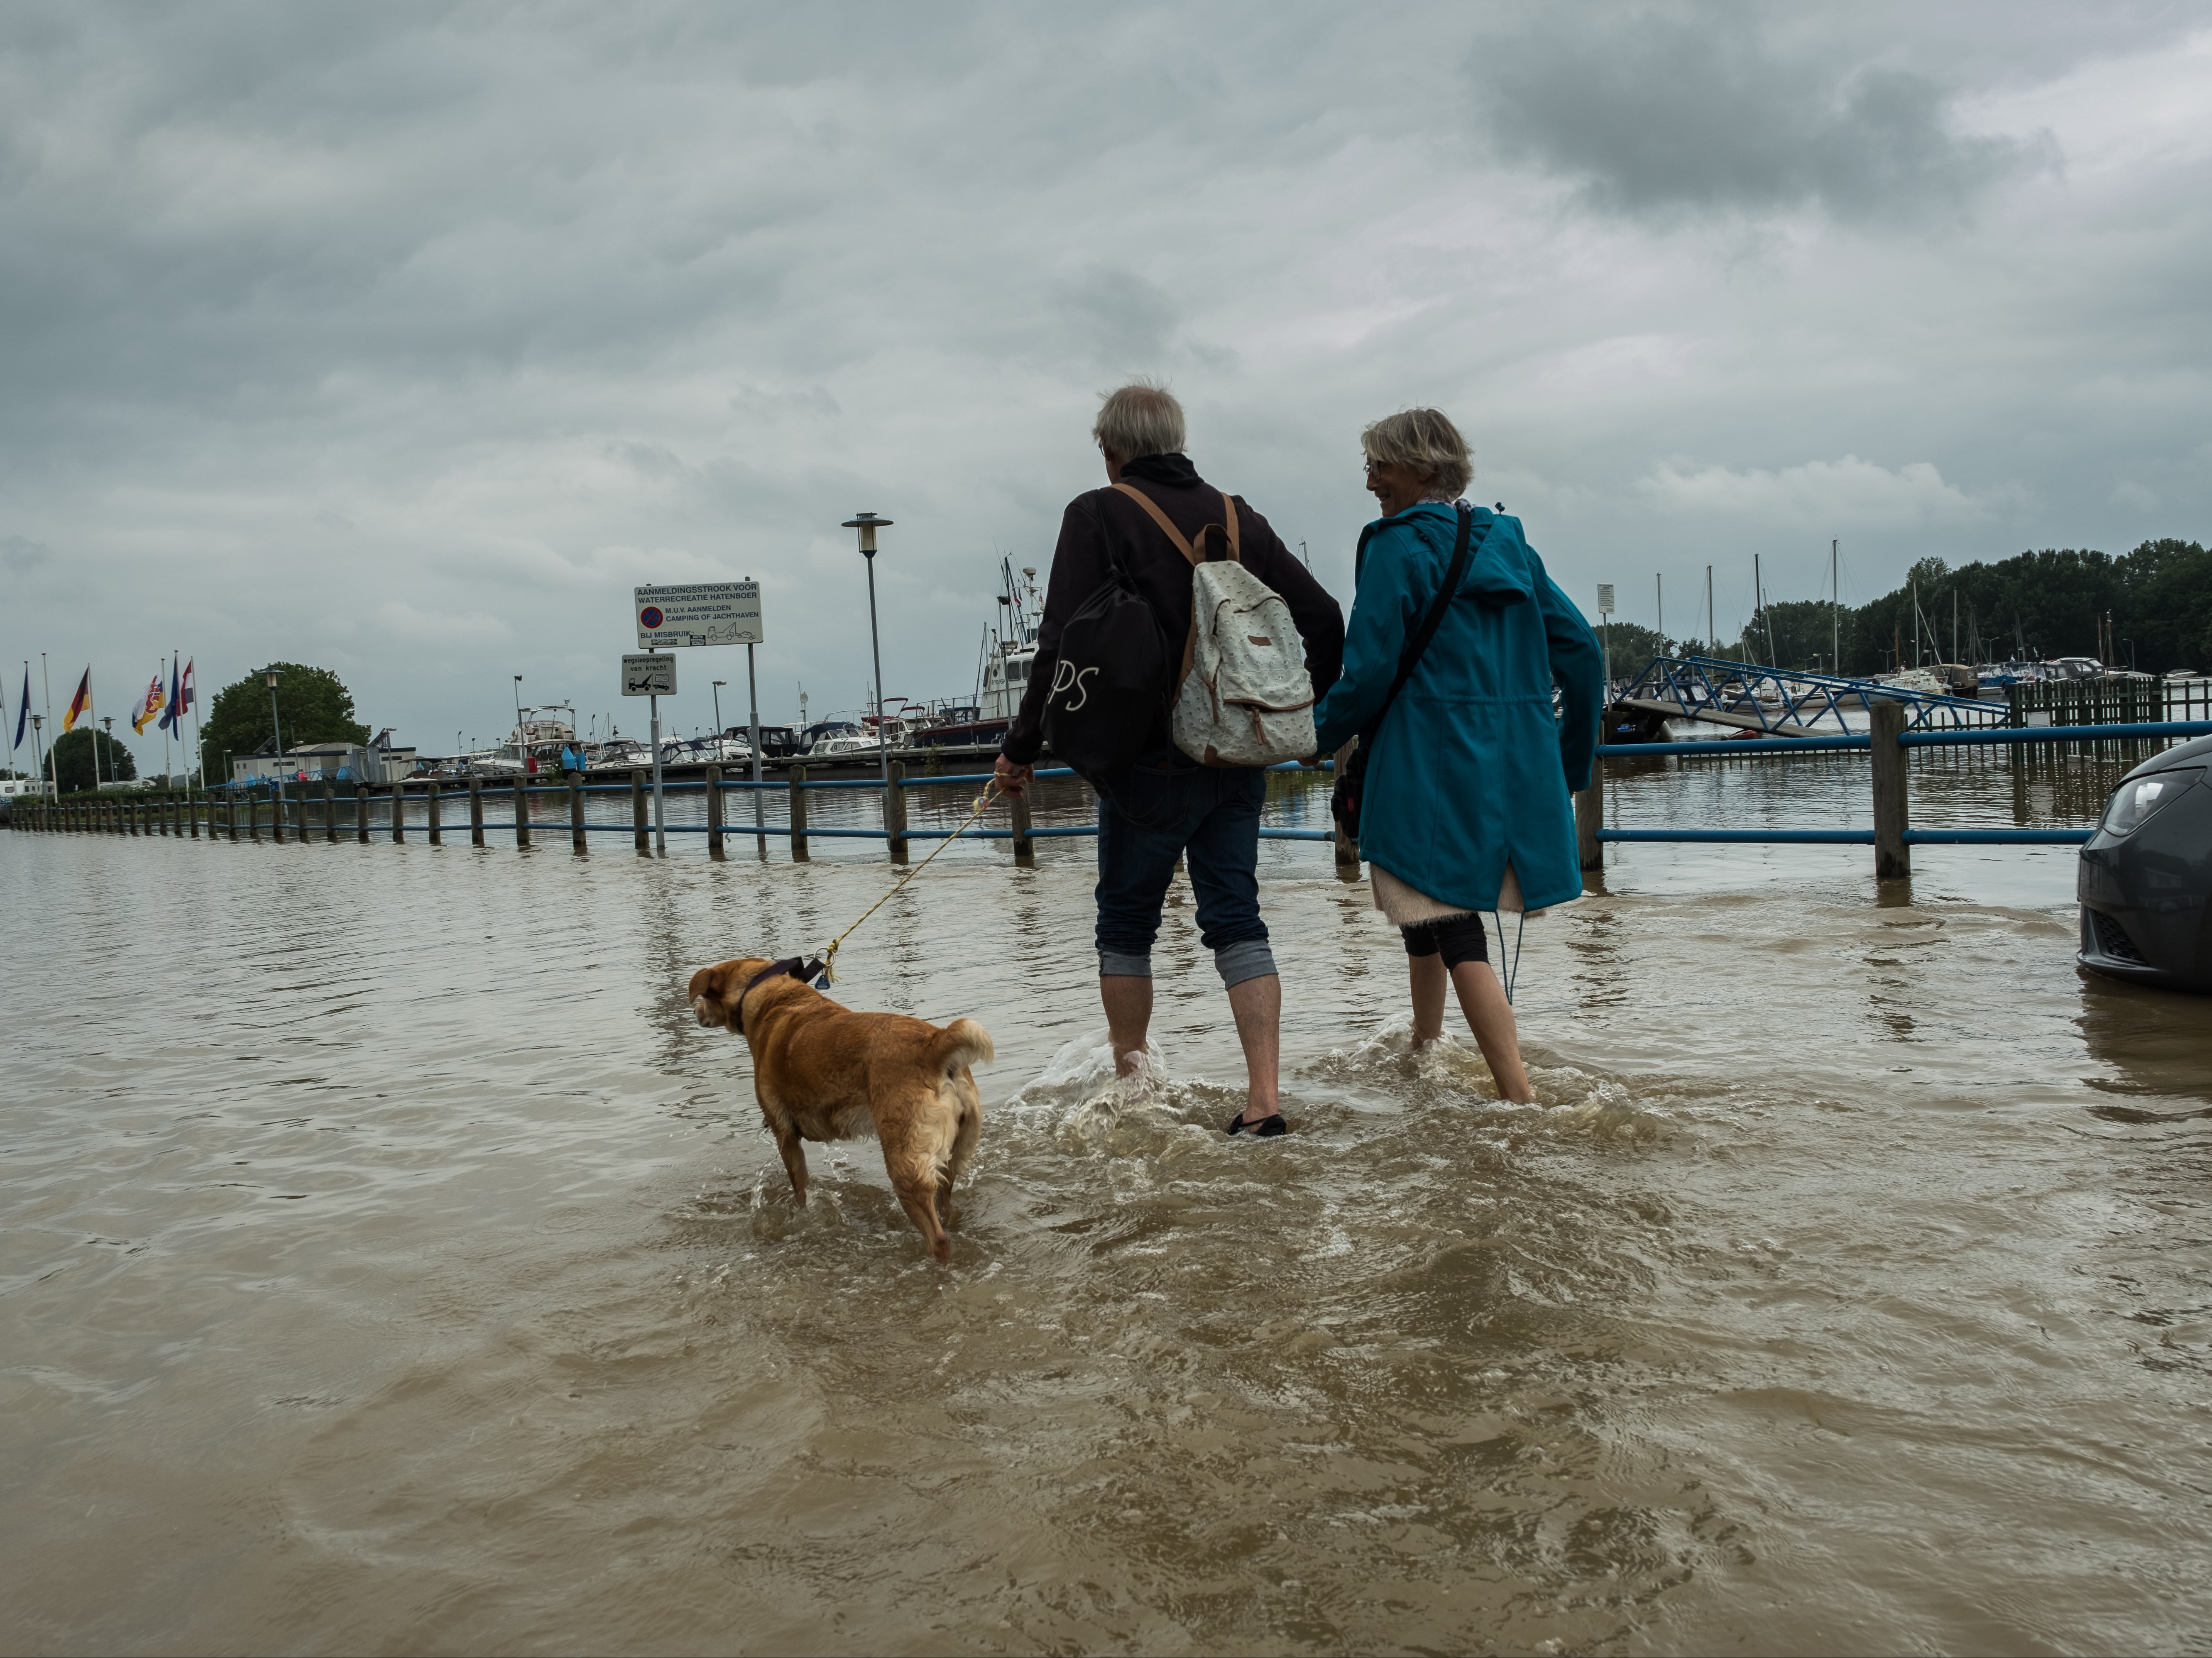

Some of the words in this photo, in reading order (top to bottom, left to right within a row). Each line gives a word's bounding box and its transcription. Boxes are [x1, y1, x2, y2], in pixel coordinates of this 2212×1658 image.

[638, 585, 732, 596] AANMELDINGSSTROOK
[638, 594, 708, 604] WATERRECREATIE
[710, 592, 757, 600] HATENBOER
[624, 656, 673, 665] wegsleepregeling
